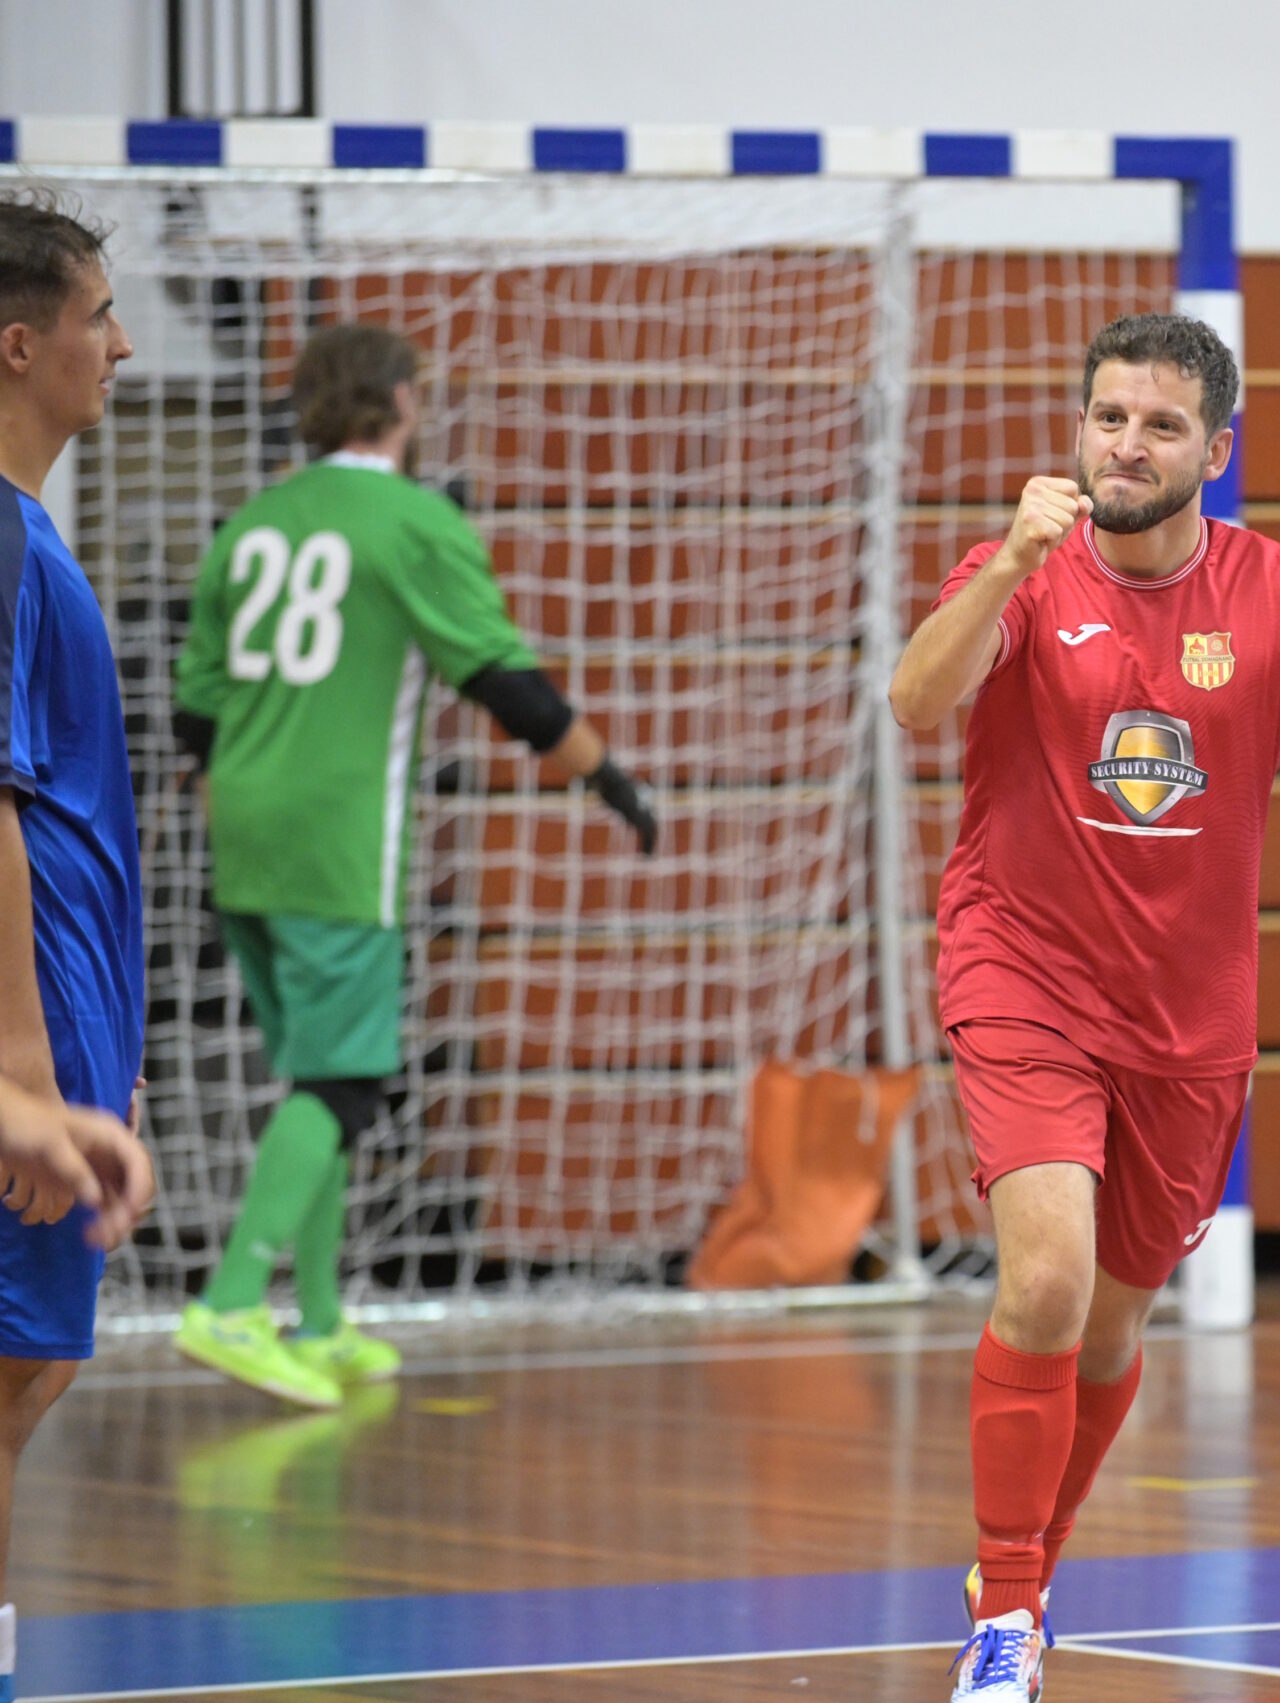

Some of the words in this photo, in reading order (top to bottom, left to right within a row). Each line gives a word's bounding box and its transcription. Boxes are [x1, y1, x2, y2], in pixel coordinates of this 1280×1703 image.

[228, 525, 352, 686] 28
[1091, 761, 1151, 778] SECURITY
[1154, 762, 1204, 787] SYSTEM
